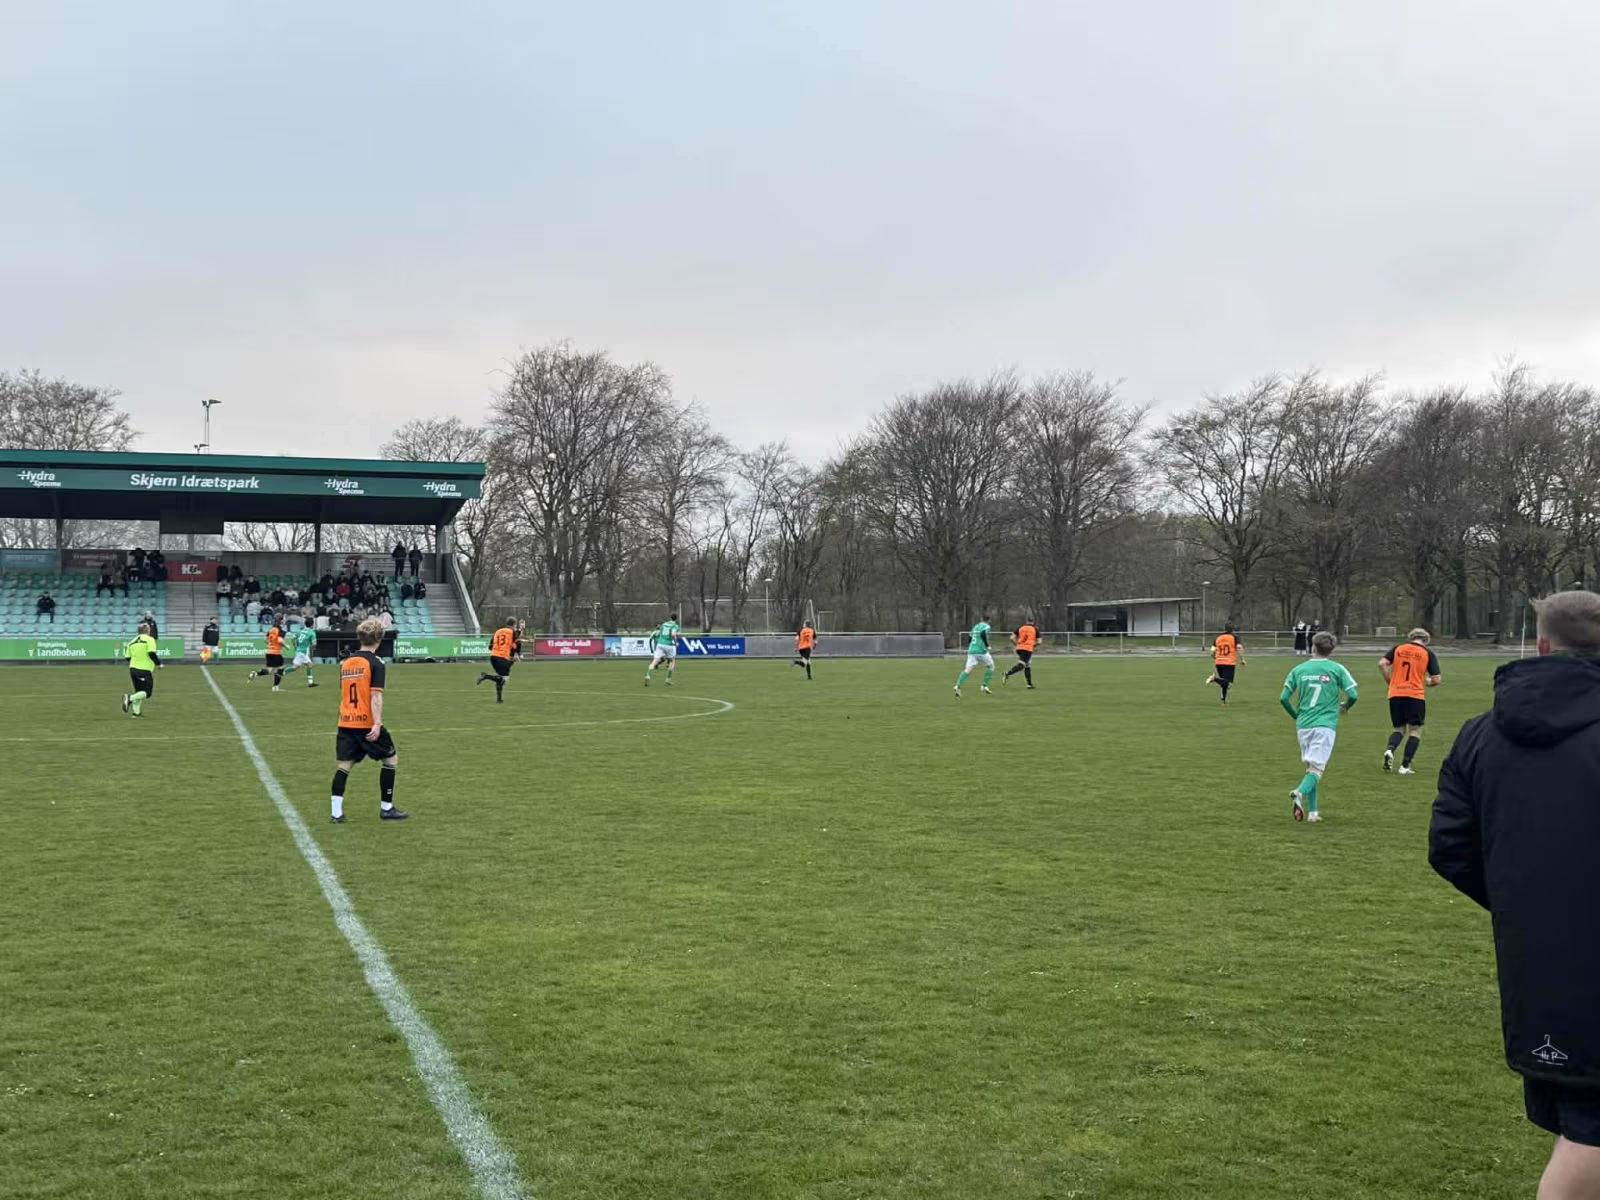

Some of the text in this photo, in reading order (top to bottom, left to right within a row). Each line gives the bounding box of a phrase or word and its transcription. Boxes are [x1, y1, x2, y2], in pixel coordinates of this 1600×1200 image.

[17, 470, 56, 483] Hydra
[130, 473, 260, 491] Skjern Idrætspark
[324, 478, 359, 491] Hydra
[422, 481, 457, 493] Hydra
[37, 648, 87, 657] Landbobank
[226, 647, 267, 656] Landboban
[1402, 661, 1411, 681] 7
[349, 682, 359, 709] 4
[1308, 683, 1322, 708] 7
